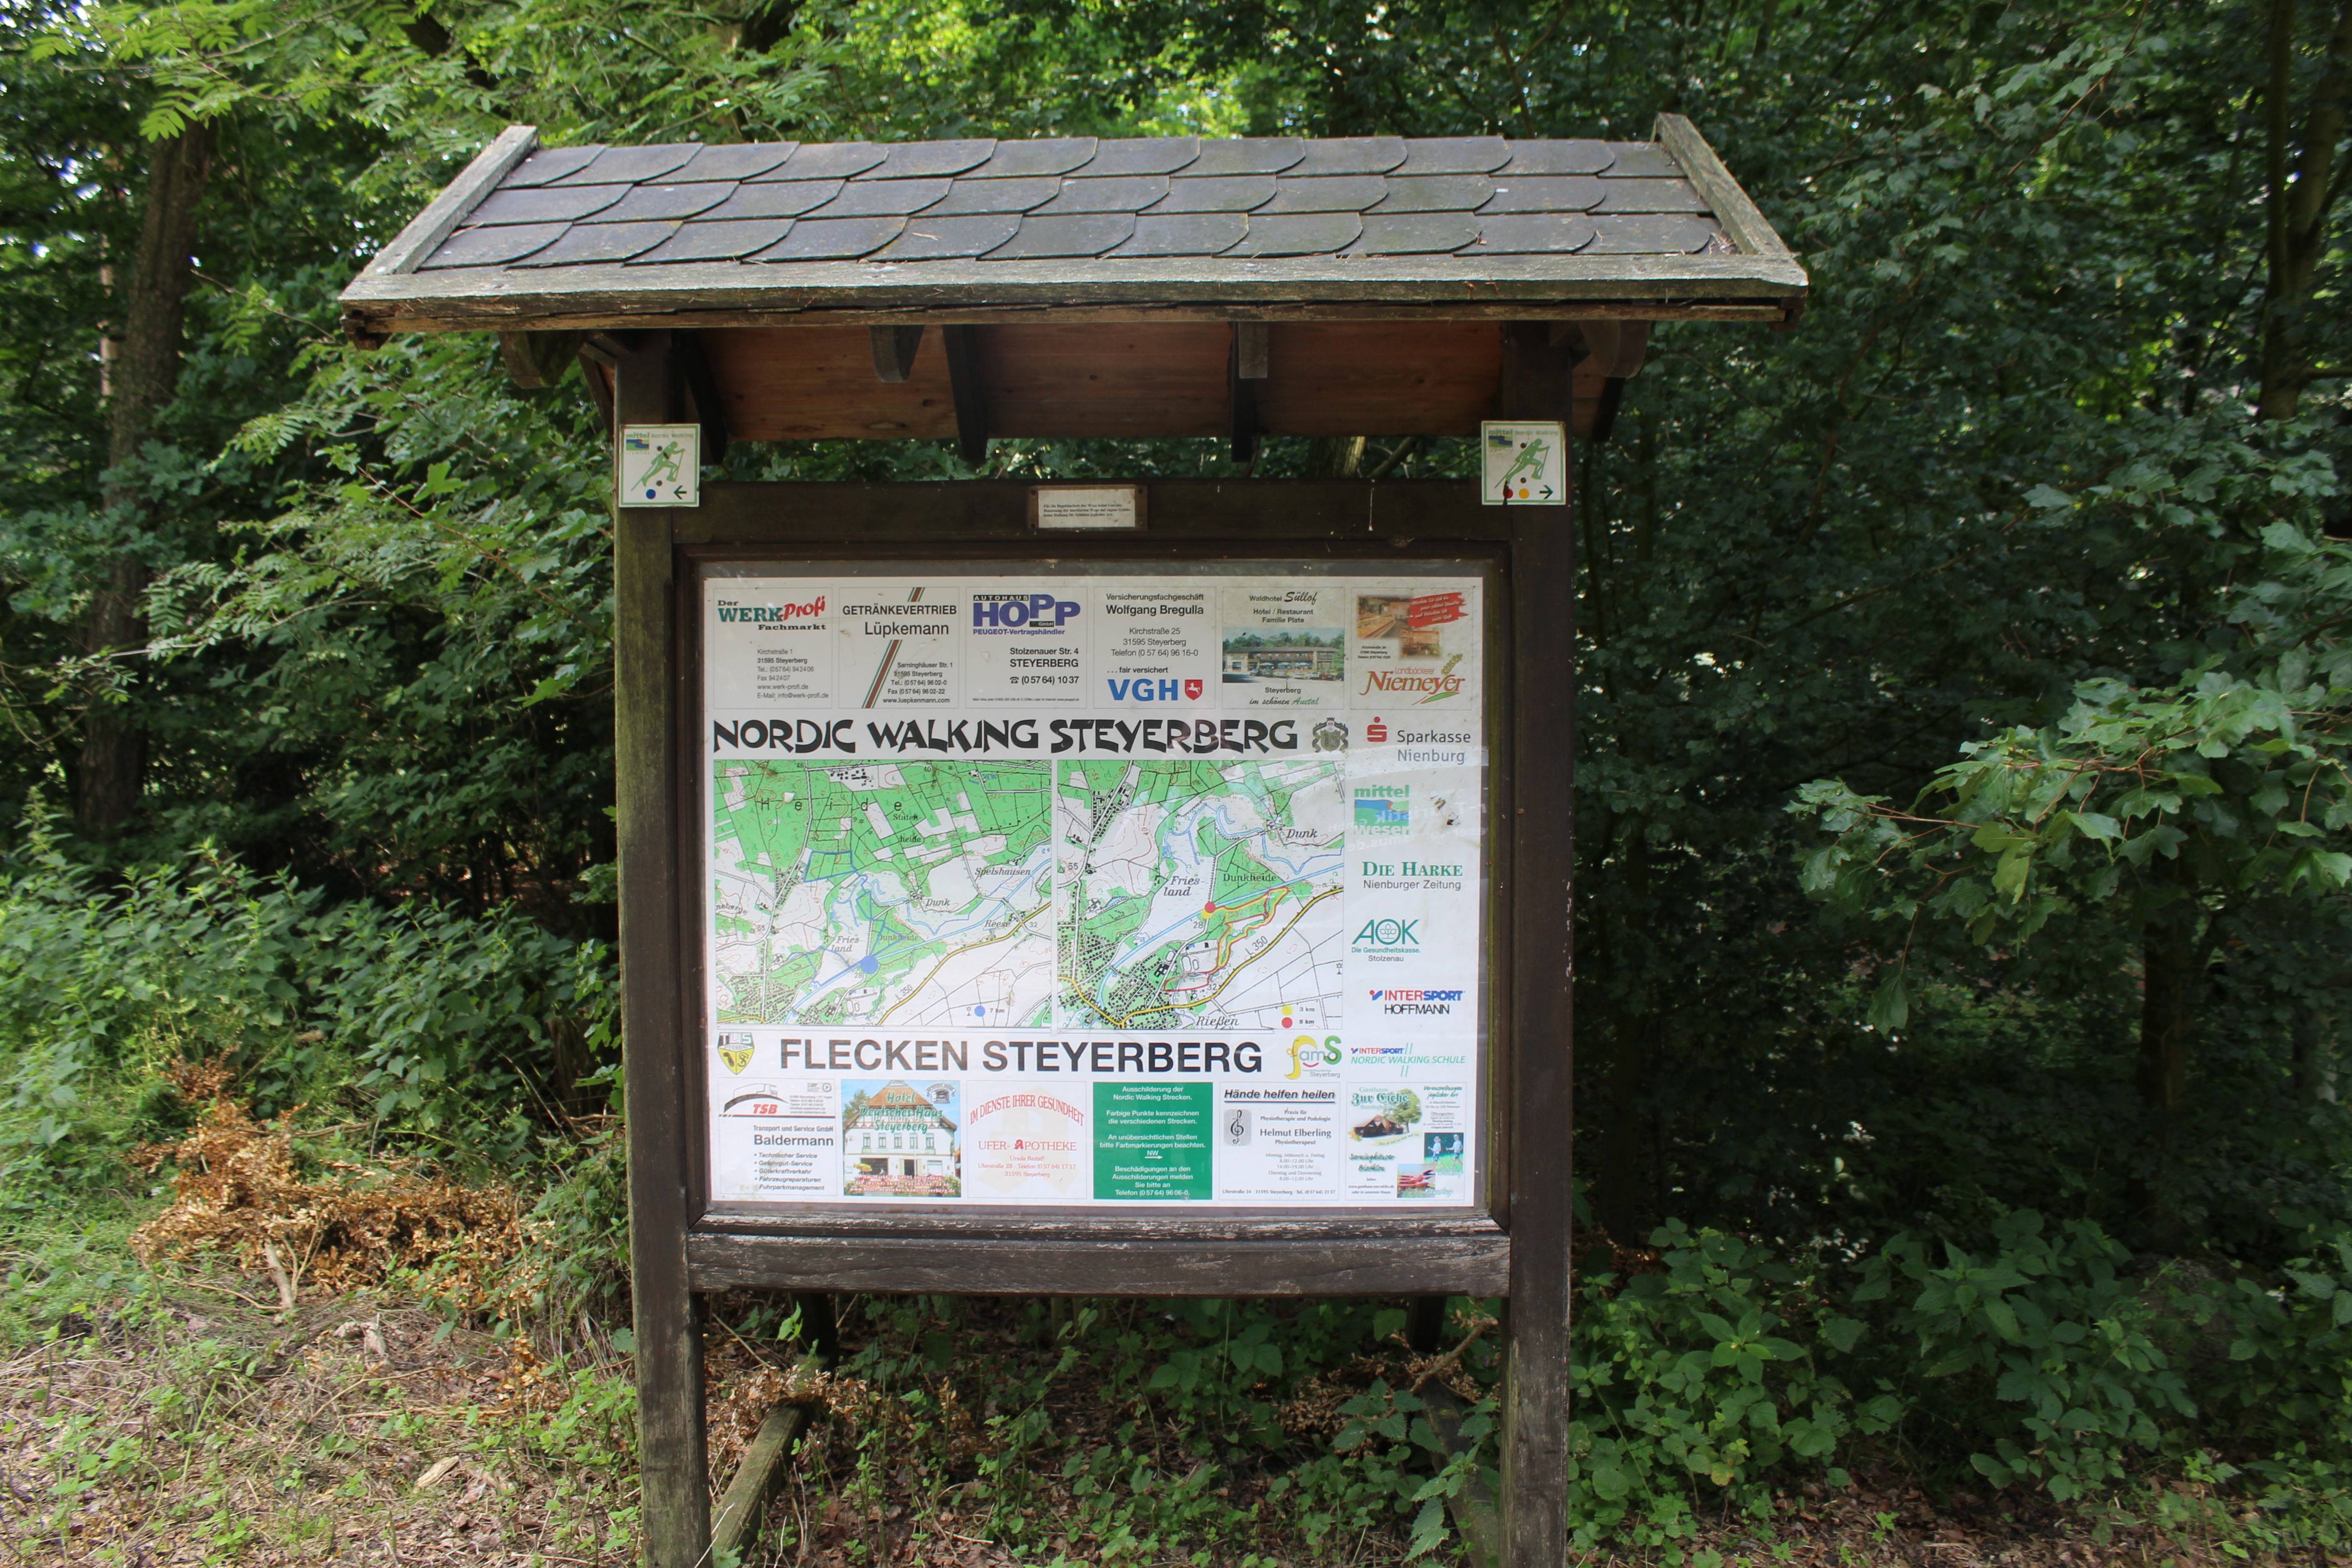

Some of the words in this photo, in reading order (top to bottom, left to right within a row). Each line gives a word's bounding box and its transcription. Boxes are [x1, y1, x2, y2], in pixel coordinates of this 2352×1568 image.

[1284, 592, 1317, 605] Süllof
[843, 603, 956, 615] GETRÄNKEVERTRIEB
[973, 594, 1080, 626] HOPP
[1106, 605, 1156, 616] Wolfgang
[1160, 605, 1203, 616] Bregulla
[865, 622, 948, 638] Lüpkemann
[972, 628, 1065, 636] PEUGEOT-Vertragshändler
[1148, 638, 1186, 647] Steyerberg
[1395, 666, 1435, 676] Landbäckerei
[1359, 670, 1465, 696] Niemeyer
[1107, 679, 1178, 701] VGH
[1262, 696, 1289, 705] schönen
[713, 719, 856, 753] NORDIC
[867, 719, 1039, 753] WALKING
[1050, 719, 1298, 754] STEYERBERG
[1397, 730, 1470, 745] Sparkasse
[1398, 749, 1465, 765] Nienburg
[1354, 784, 1410, 798] mittel
[1287, 828, 1317, 838] Dunk
[975, 866, 1030, 876] Spelshausen
[1363, 862, 1394, 876] DIE
[1402, 862, 1462, 876] HARKE
[1170, 875, 1205, 887] Fries-
[1223, 872, 1277, 882] Dunkheide
[1364, 880, 1420, 891] Nienburger
[1423, 880, 1461, 891] Zeitung
[1163, 887, 1192, 897] land
[926, 898, 950, 906] Dunk
[985, 918, 1011, 928] Reese
[1352, 919, 1419, 945] AOK
[1385, 990, 1463, 1001] INTERSPORT
[1385, 1004, 1449, 1014] HOFFMANN
[1196, 1015, 1240, 1027] Rießen
[780, 1039, 968, 1071] FLECKEN
[982, 1041, 1262, 1073] STEYERBERG
[886, 1091, 916, 1104] Hotel
[1225, 1090, 1260, 1098] Hände
[1264, 1090, 1298, 1098] helfen
[1302, 1090, 1334, 1099] heilen
[1351, 1093, 1369, 1105] Zur
[1376, 1093, 1409, 1104] Eiche
[752, 1103, 777, 1114] TSB
[859, 1105, 914, 1117] Deutsches
[916, 1106, 943, 1117] Haus
[970, 1107, 978, 1125] IM
[980, 1096, 1011, 1116] DIENSTE
[1012, 1094, 1036, 1107] IHRER
[1038, 1096, 1084, 1127] GESUNDHEIT
[874, 1119, 928, 1134] Steyerberg
[1295, 1129, 1331, 1138] Elberling
[755, 1135, 833, 1146] Baldermann
[978, 1140, 1010, 1150] UFER-
[1014, 1139, 1077, 1151] APOTHEKE
